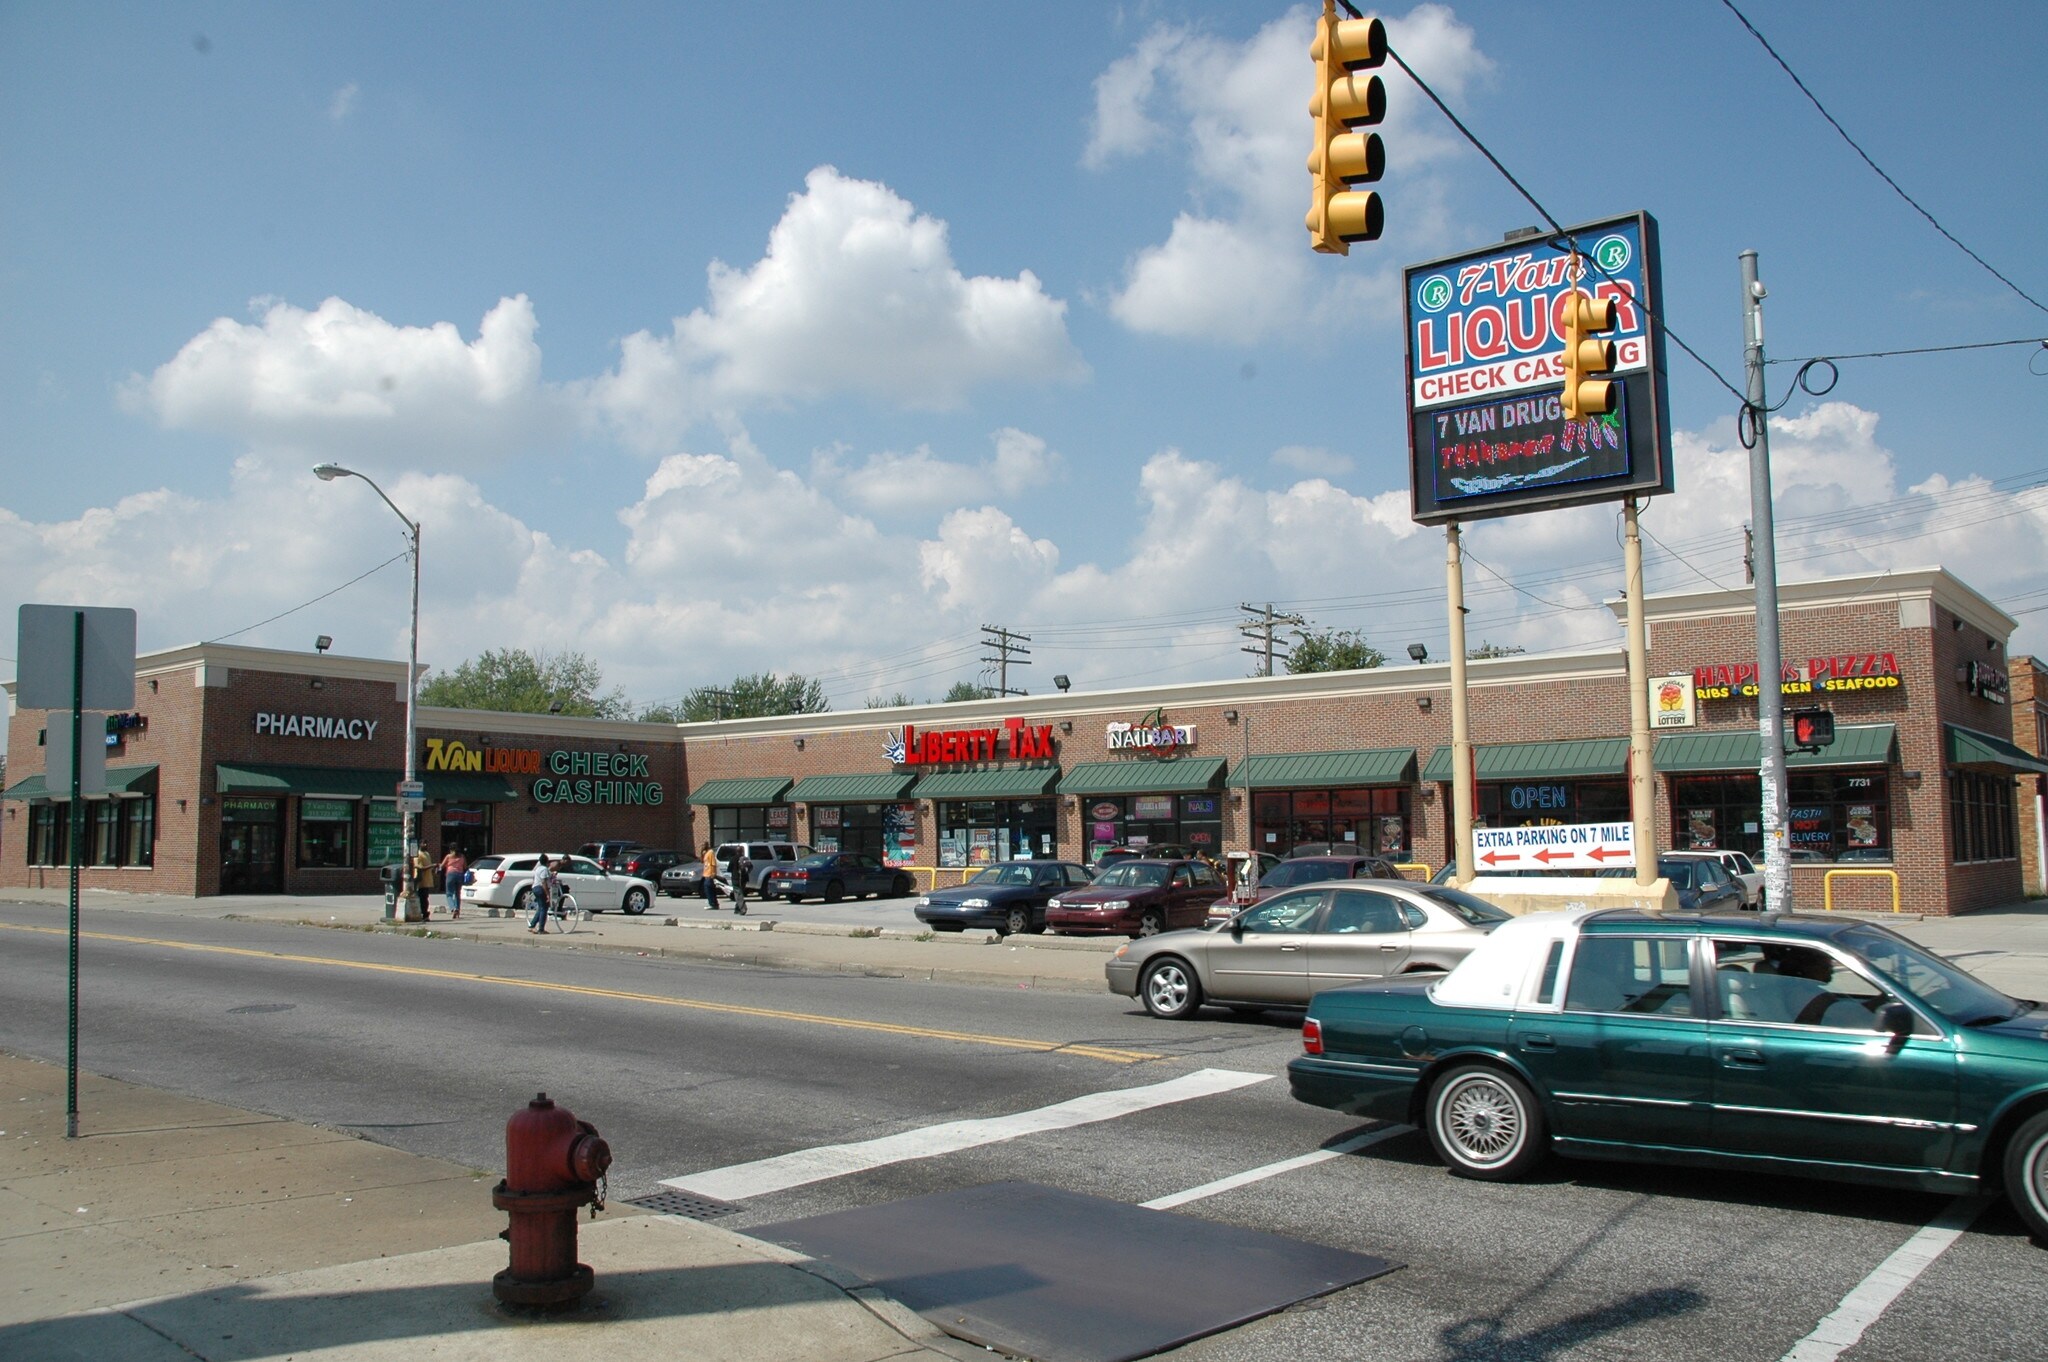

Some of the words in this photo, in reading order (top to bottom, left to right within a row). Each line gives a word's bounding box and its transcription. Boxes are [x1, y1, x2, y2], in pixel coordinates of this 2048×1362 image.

[1458, 253, 1587, 306] 7-Van
[1420, 365, 1507, 400] CHECK
[1514, 341, 1640, 384] CASG
[1438, 415, 1449, 439] 7
[1455, 408, 1496, 436] VAN
[1503, 395, 1566, 429] DRUG
[1808, 652, 1900, 680] PIZZA
[1657, 680, 1686, 691] MICHIGAN
[1696, 687, 1730, 699] RIBS
[1742, 682, 1812, 696] CHKEN
[1825, 676, 1899, 691] SEAFOOD
[256, 712, 378, 741] PHARMACY
[1658, 716, 1686, 726] LOTTERY
[905, 724, 1000, 765] LIBERTY
[1004, 717, 1053, 760] TAX
[1110, 728, 1152, 749] NAIL
[1151, 727, 1186, 747] BAR
[485, 747, 540, 774] LIQUOR
[550, 750, 649, 778] CHECK
[533, 778, 664, 806] CASHING
[1848, 778, 1871, 788] 7731
[223, 801, 276, 811] PHARMACY
[1188, 802, 1212, 812] NAILS
[1510, 785, 1567, 809] OPEN
[770, 810, 788, 819] LEASE
[820, 810, 839, 820] LEASE
[1477, 831, 1514, 848] EXTRA
[1516, 827, 1567, 847] PARKING
[1570, 827, 1588, 844] ON
[1591, 827, 1598, 842] 7
[1601, 825, 1630, 842] MILE
[1790, 831, 1831, 842] ELIVERY
